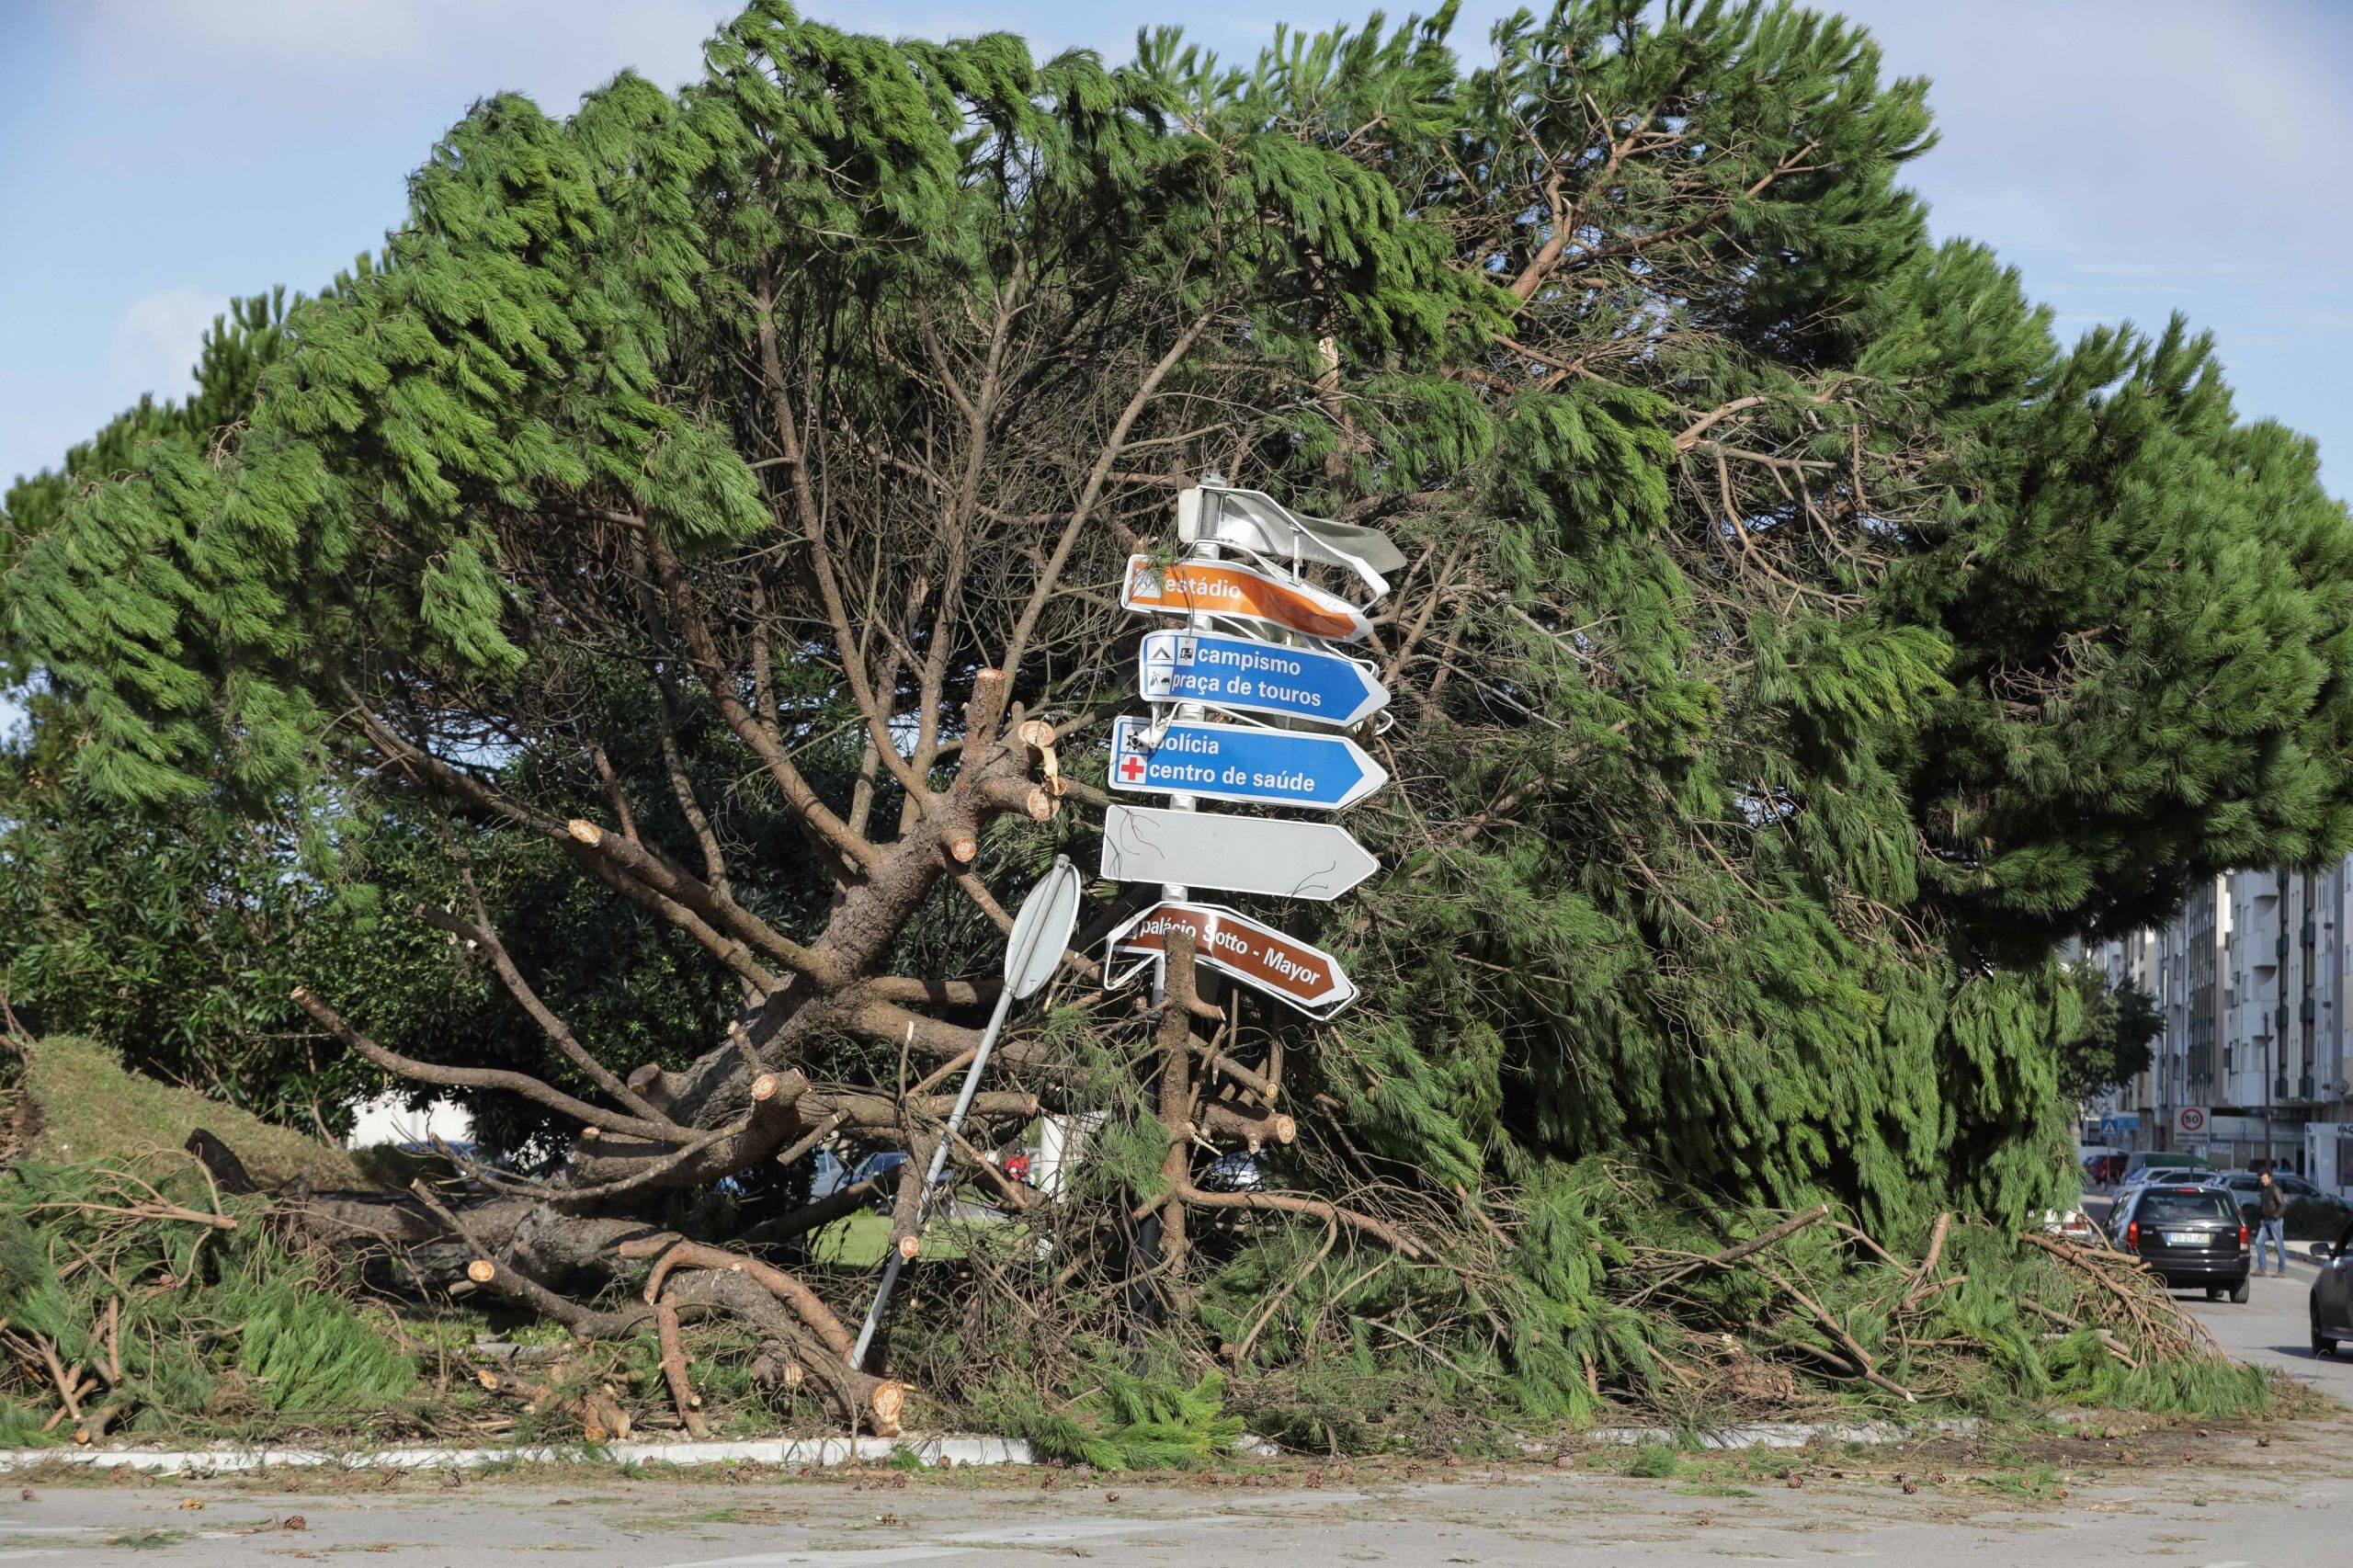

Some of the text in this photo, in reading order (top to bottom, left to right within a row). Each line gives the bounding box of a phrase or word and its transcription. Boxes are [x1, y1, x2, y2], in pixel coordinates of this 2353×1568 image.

[1164, 576, 1242, 599] estádio
[1198, 648, 1301, 676] campismo
[1171, 672, 1322, 707] praça de touros
[1149, 764, 1316, 792] centro de saúde
[1202, 924, 1248, 956] Sotto
[1263, 947, 1321, 986] Mayor
[2186, 1115, 2199, 1124] 50
